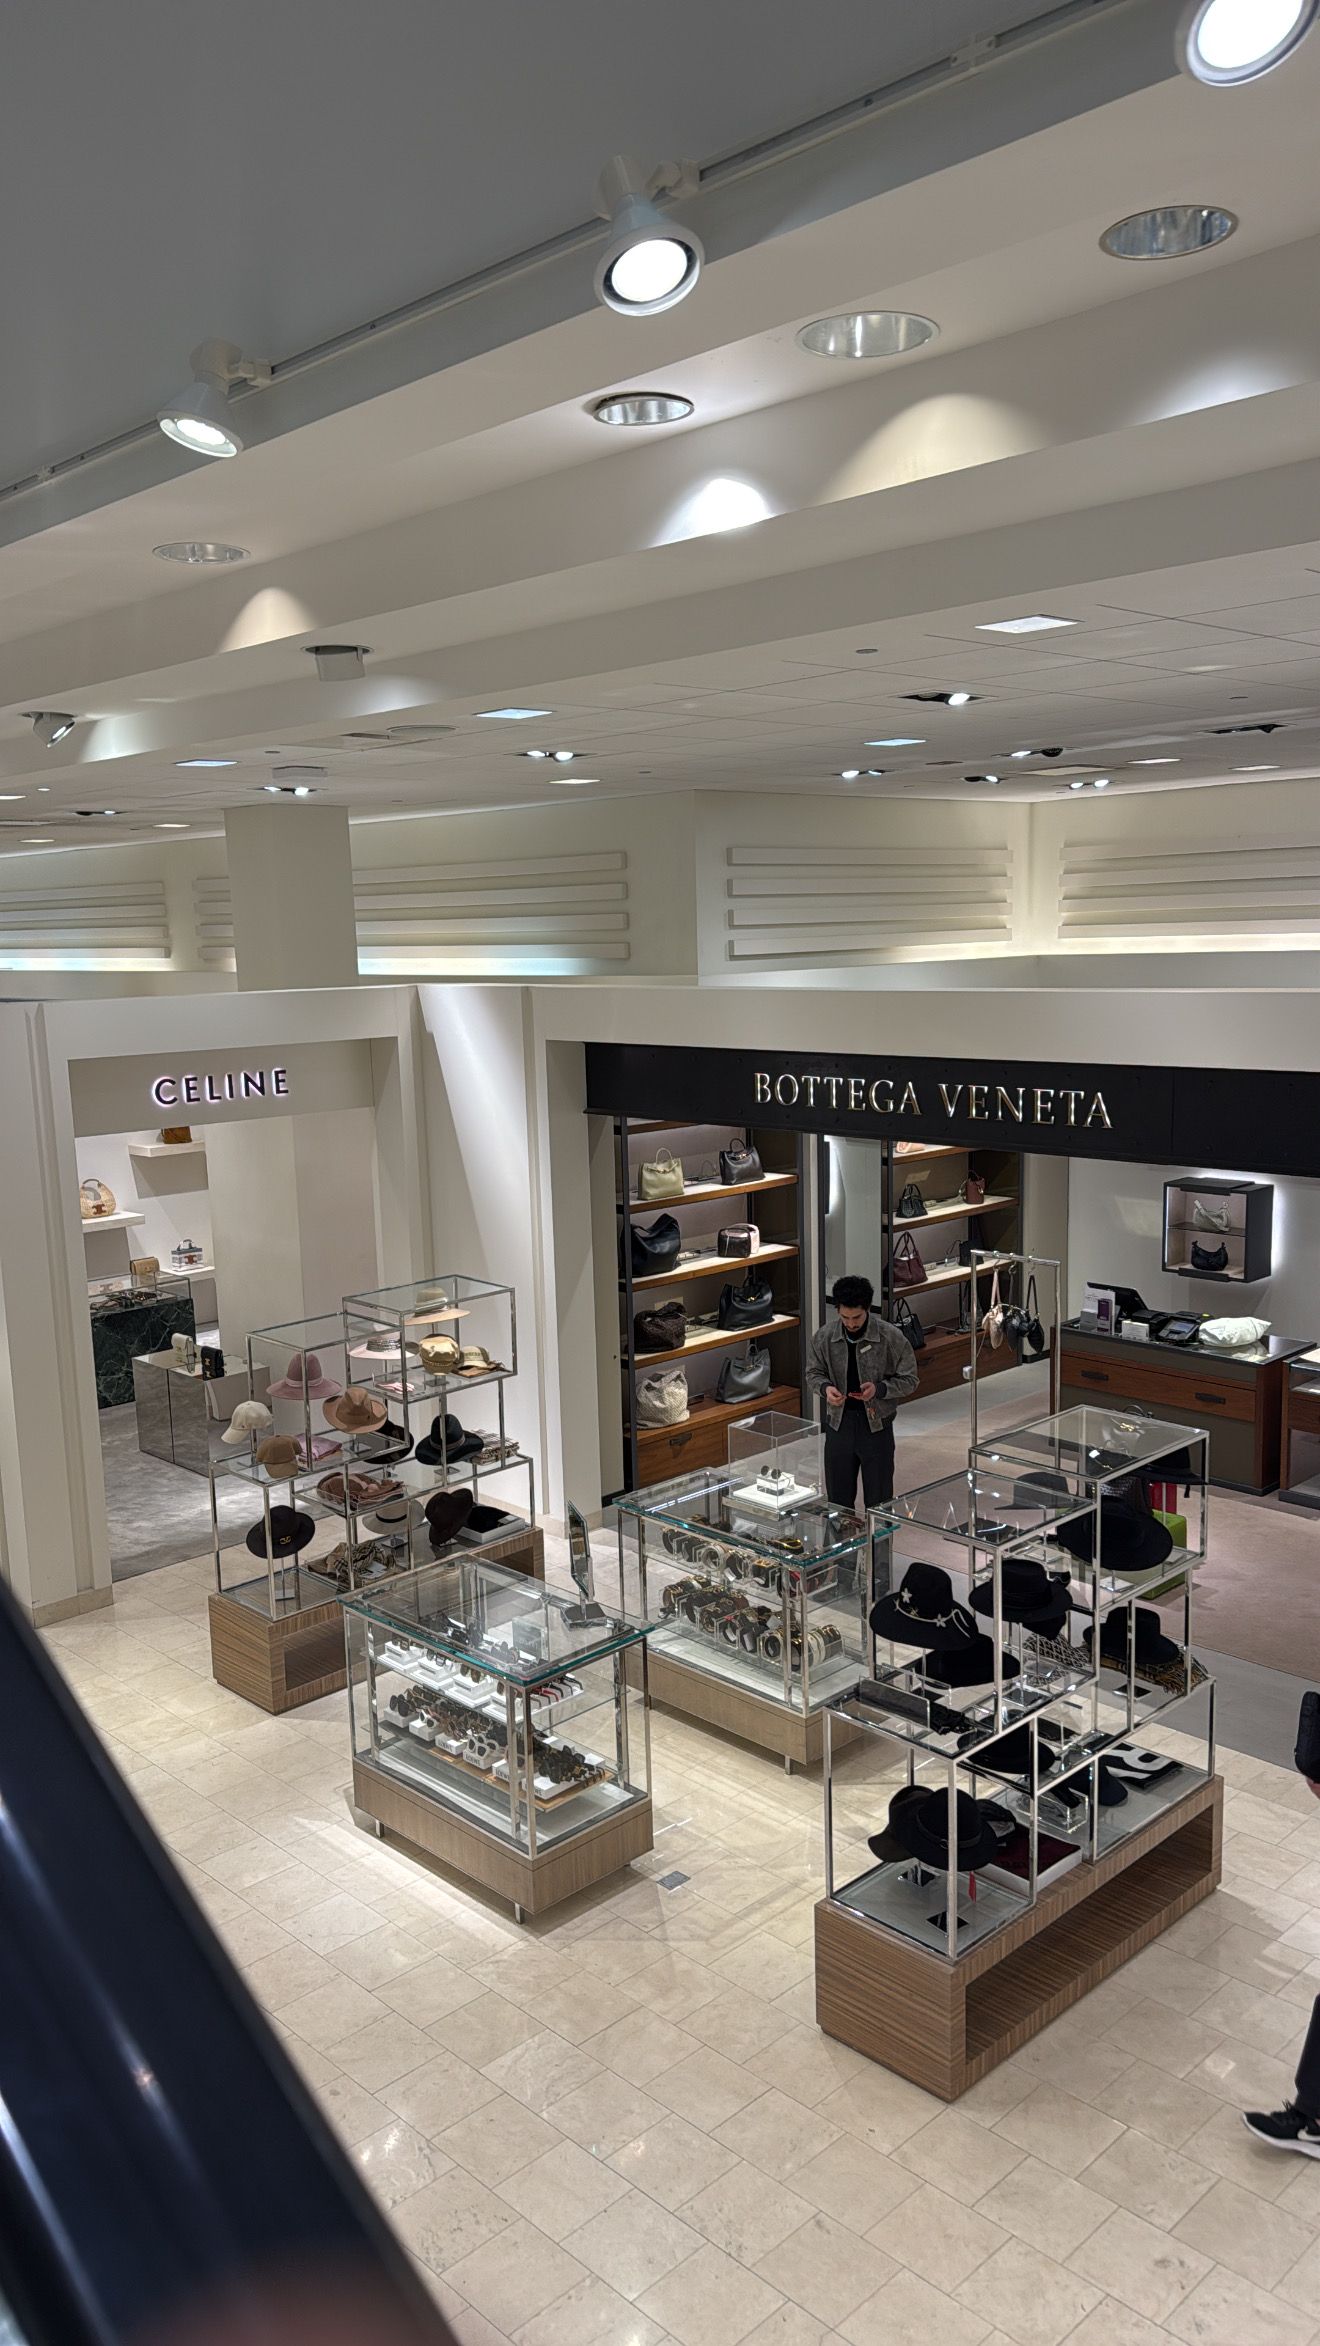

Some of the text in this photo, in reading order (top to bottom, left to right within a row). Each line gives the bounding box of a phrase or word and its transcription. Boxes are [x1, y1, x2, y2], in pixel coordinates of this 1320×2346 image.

[152, 1068, 289, 1107] CELINE
[754, 1072, 1114, 1129] BOTTEGA VENETA
